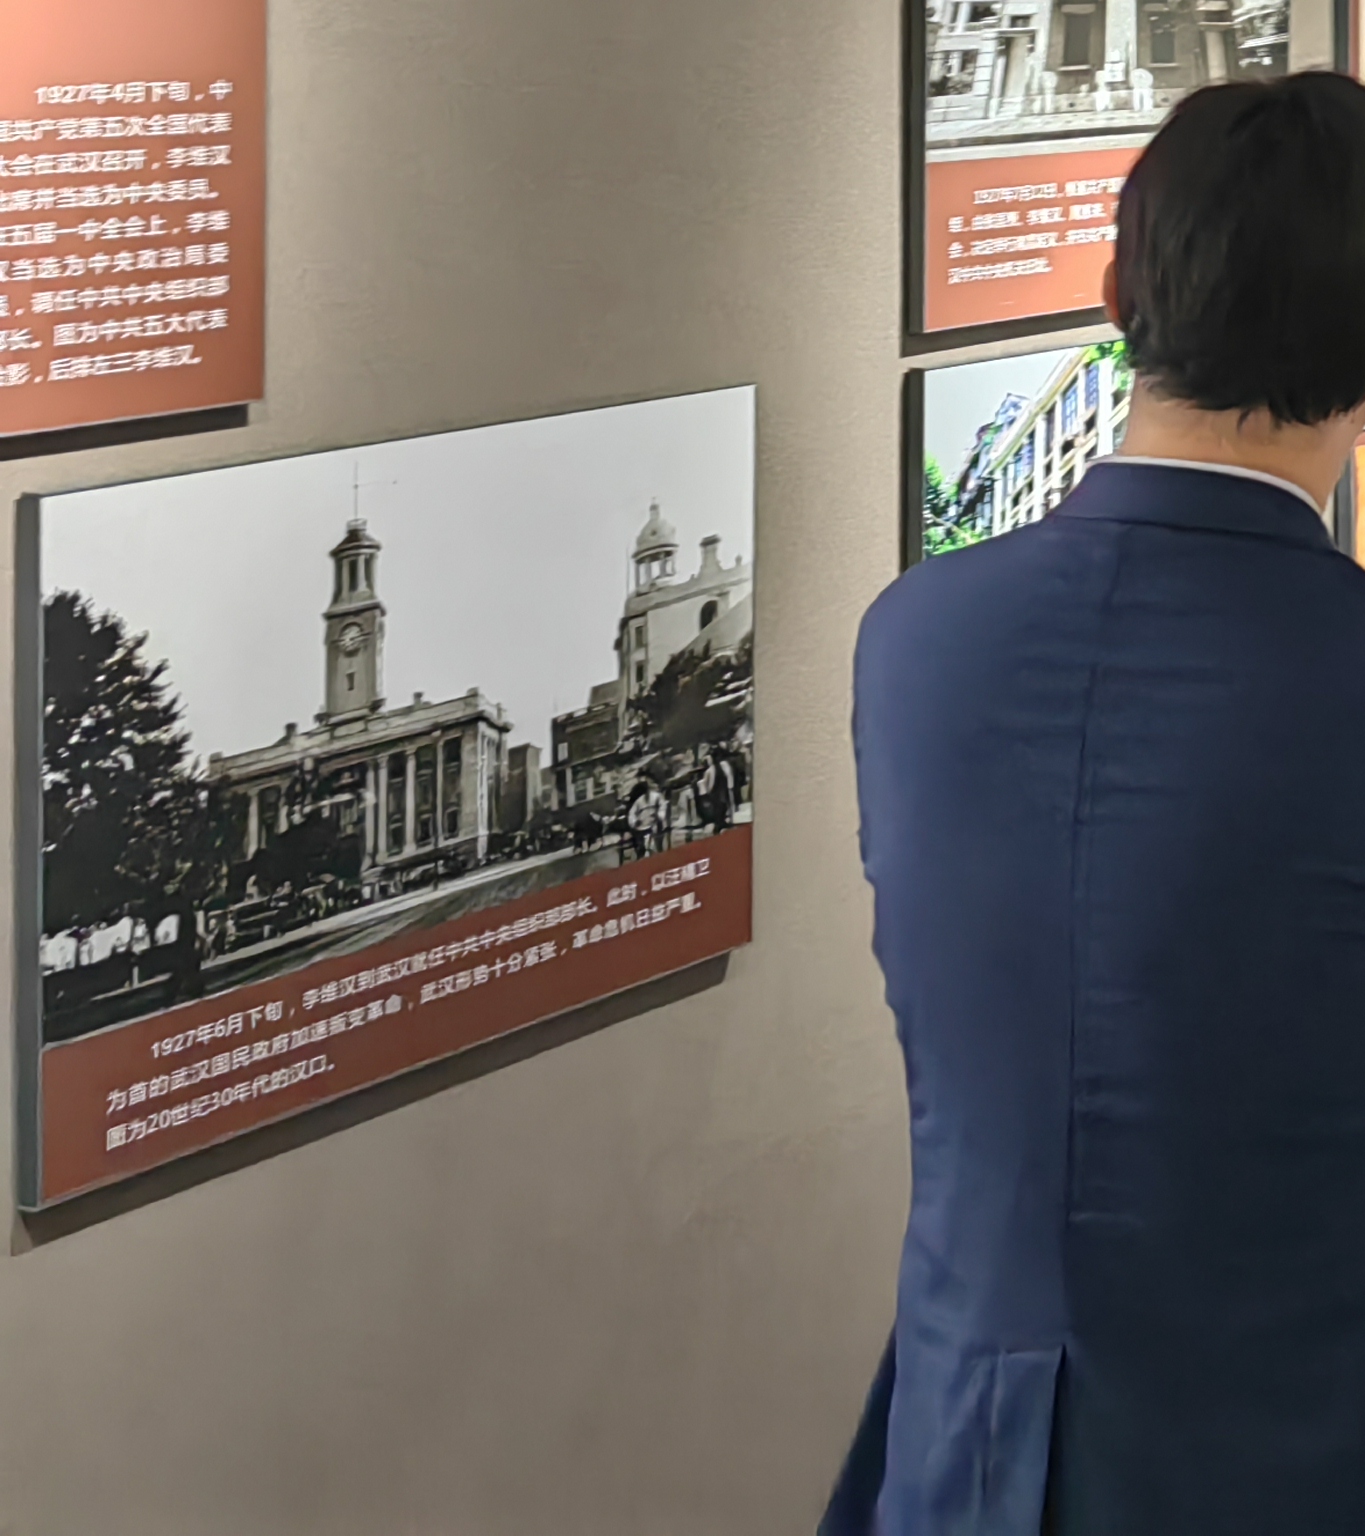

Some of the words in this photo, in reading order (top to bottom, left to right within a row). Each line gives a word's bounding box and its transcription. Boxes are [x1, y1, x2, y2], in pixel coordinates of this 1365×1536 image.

[106, 1053, 336, 1152] 图为20世纪30年代的汉口。
